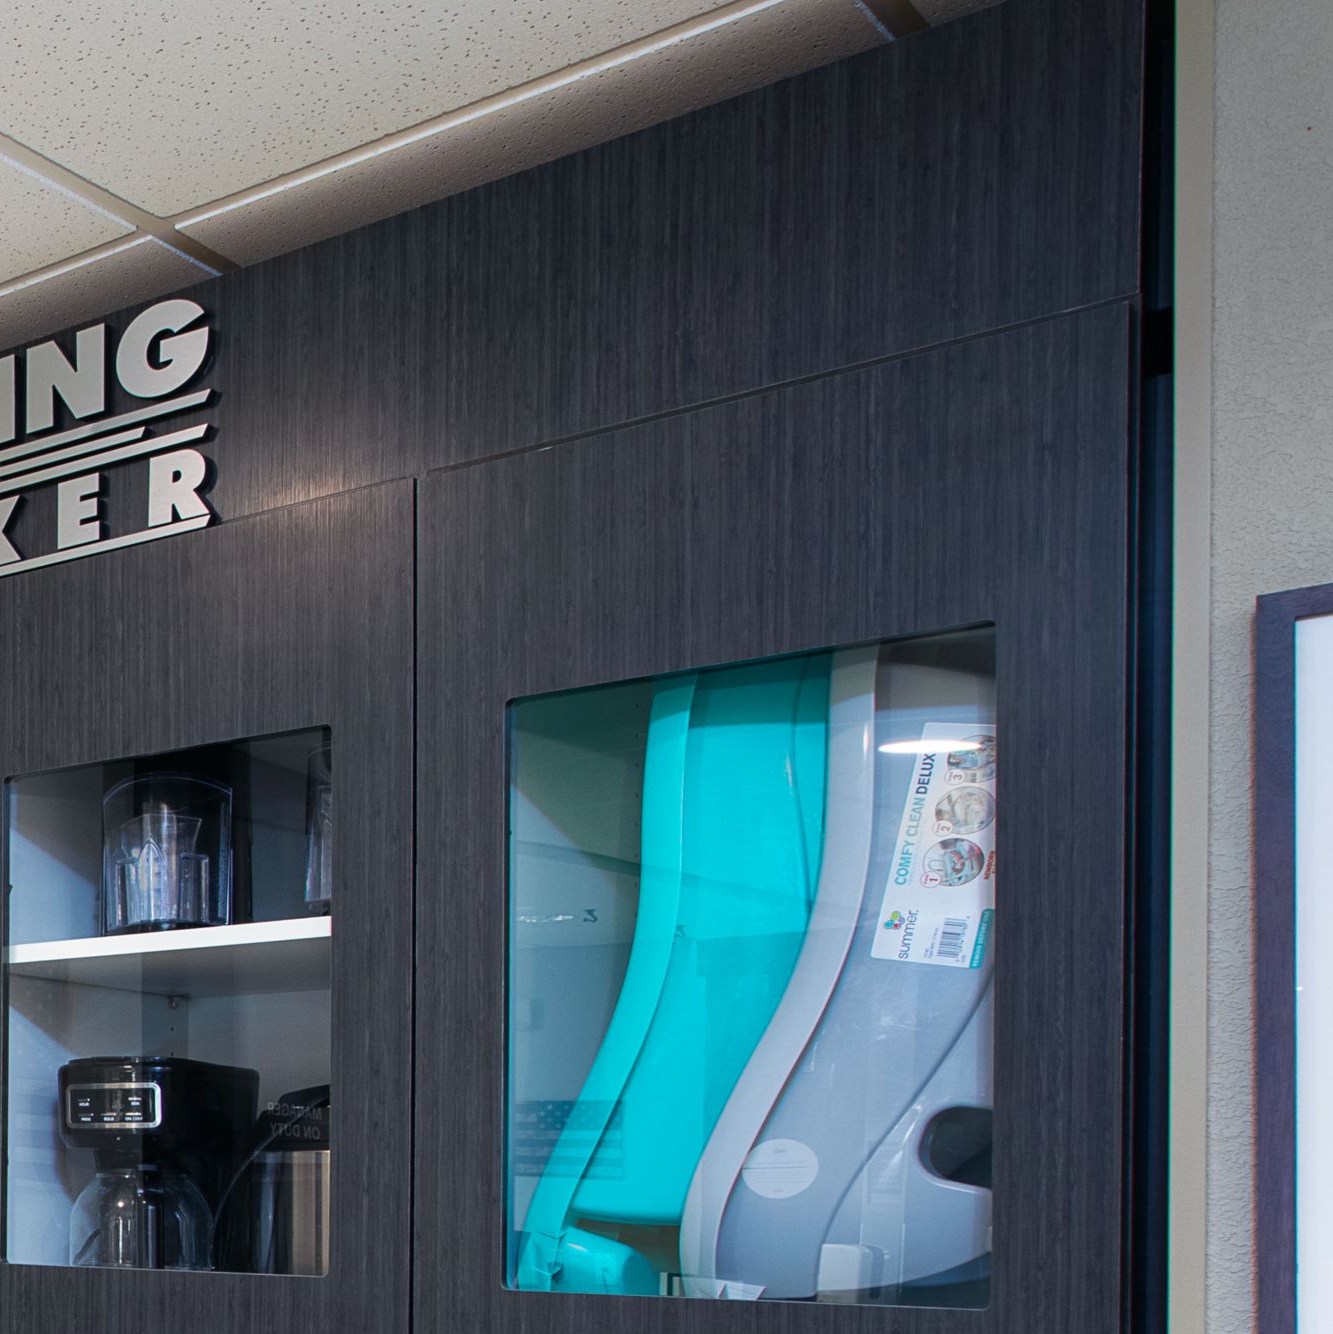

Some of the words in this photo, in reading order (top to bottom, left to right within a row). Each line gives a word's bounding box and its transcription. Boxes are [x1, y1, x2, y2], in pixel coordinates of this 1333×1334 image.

[914, 753, 937, 795] DELUX
[905, 796, 926, 837] CLEAN
[941, 824, 951, 832] 2
[894, 839, 915, 886] COMFY
